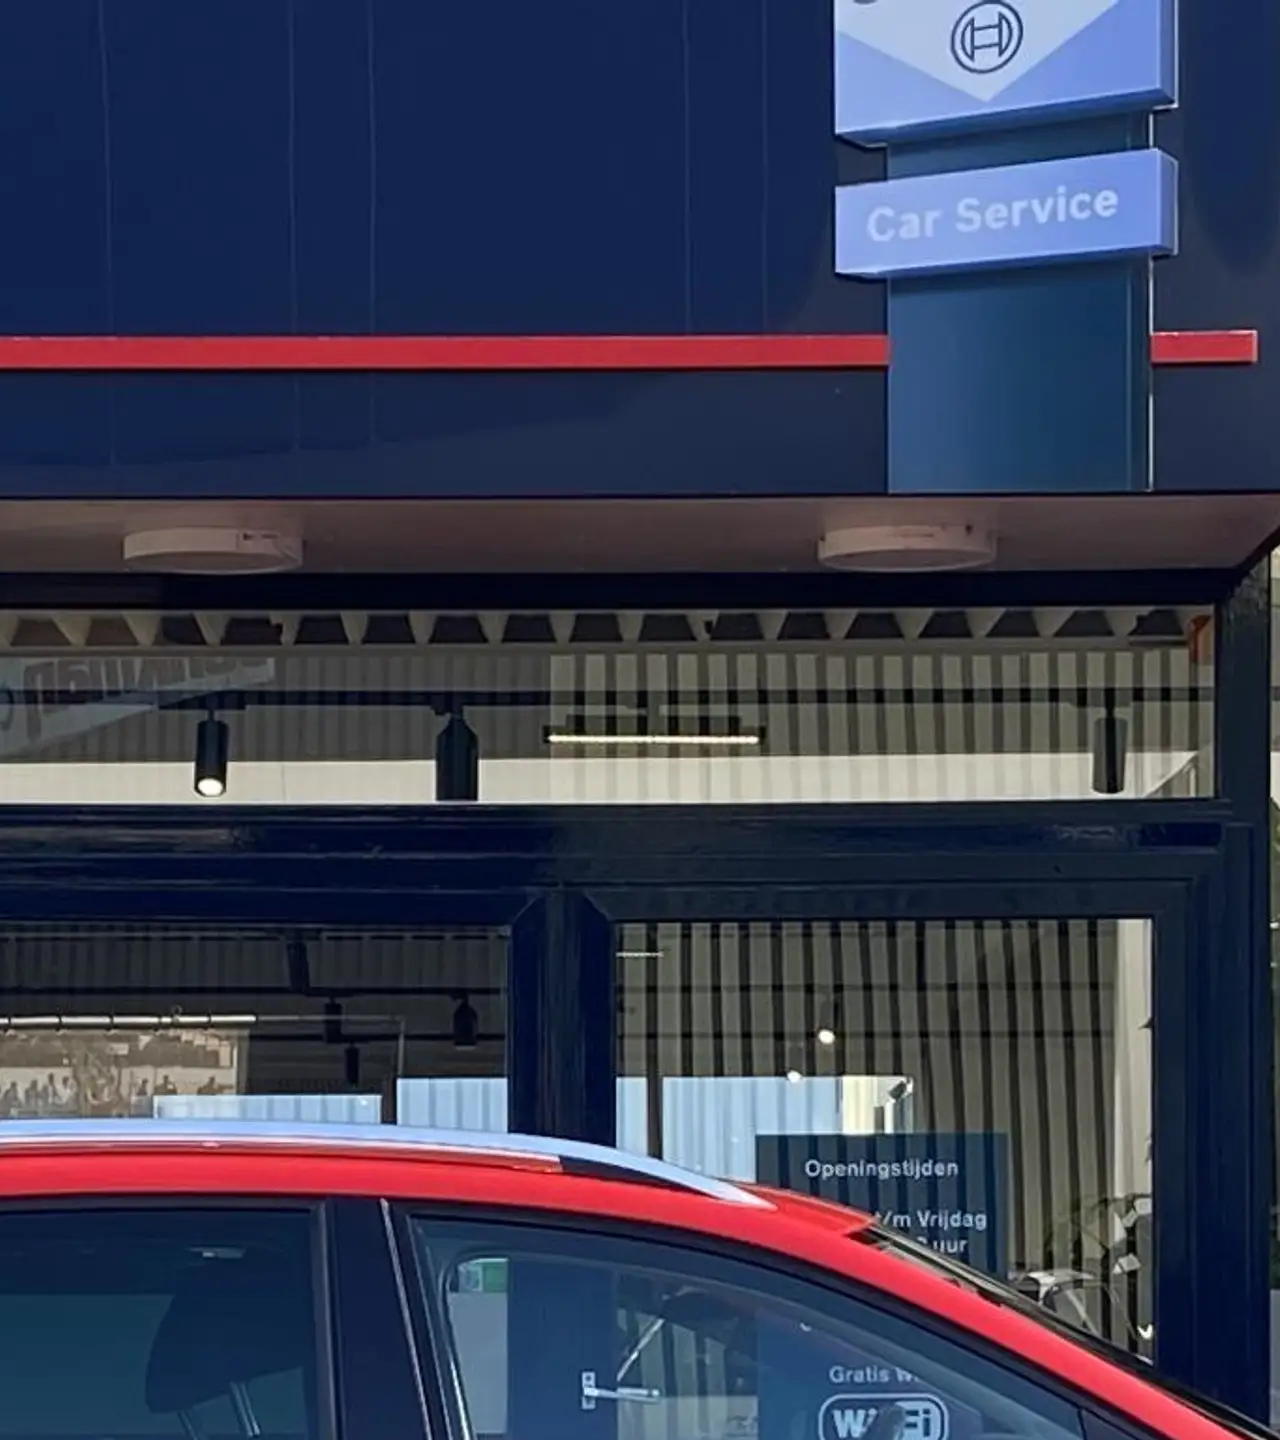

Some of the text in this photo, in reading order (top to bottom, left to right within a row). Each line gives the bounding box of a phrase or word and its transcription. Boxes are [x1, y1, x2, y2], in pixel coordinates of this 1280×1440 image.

[867, 184, 1120, 242] Car Service
[805, 1158, 959, 1181] Openingstijden
[915, 1208, 988, 1232] Vrijdag
[828, 1364, 891, 1384] Gratis
